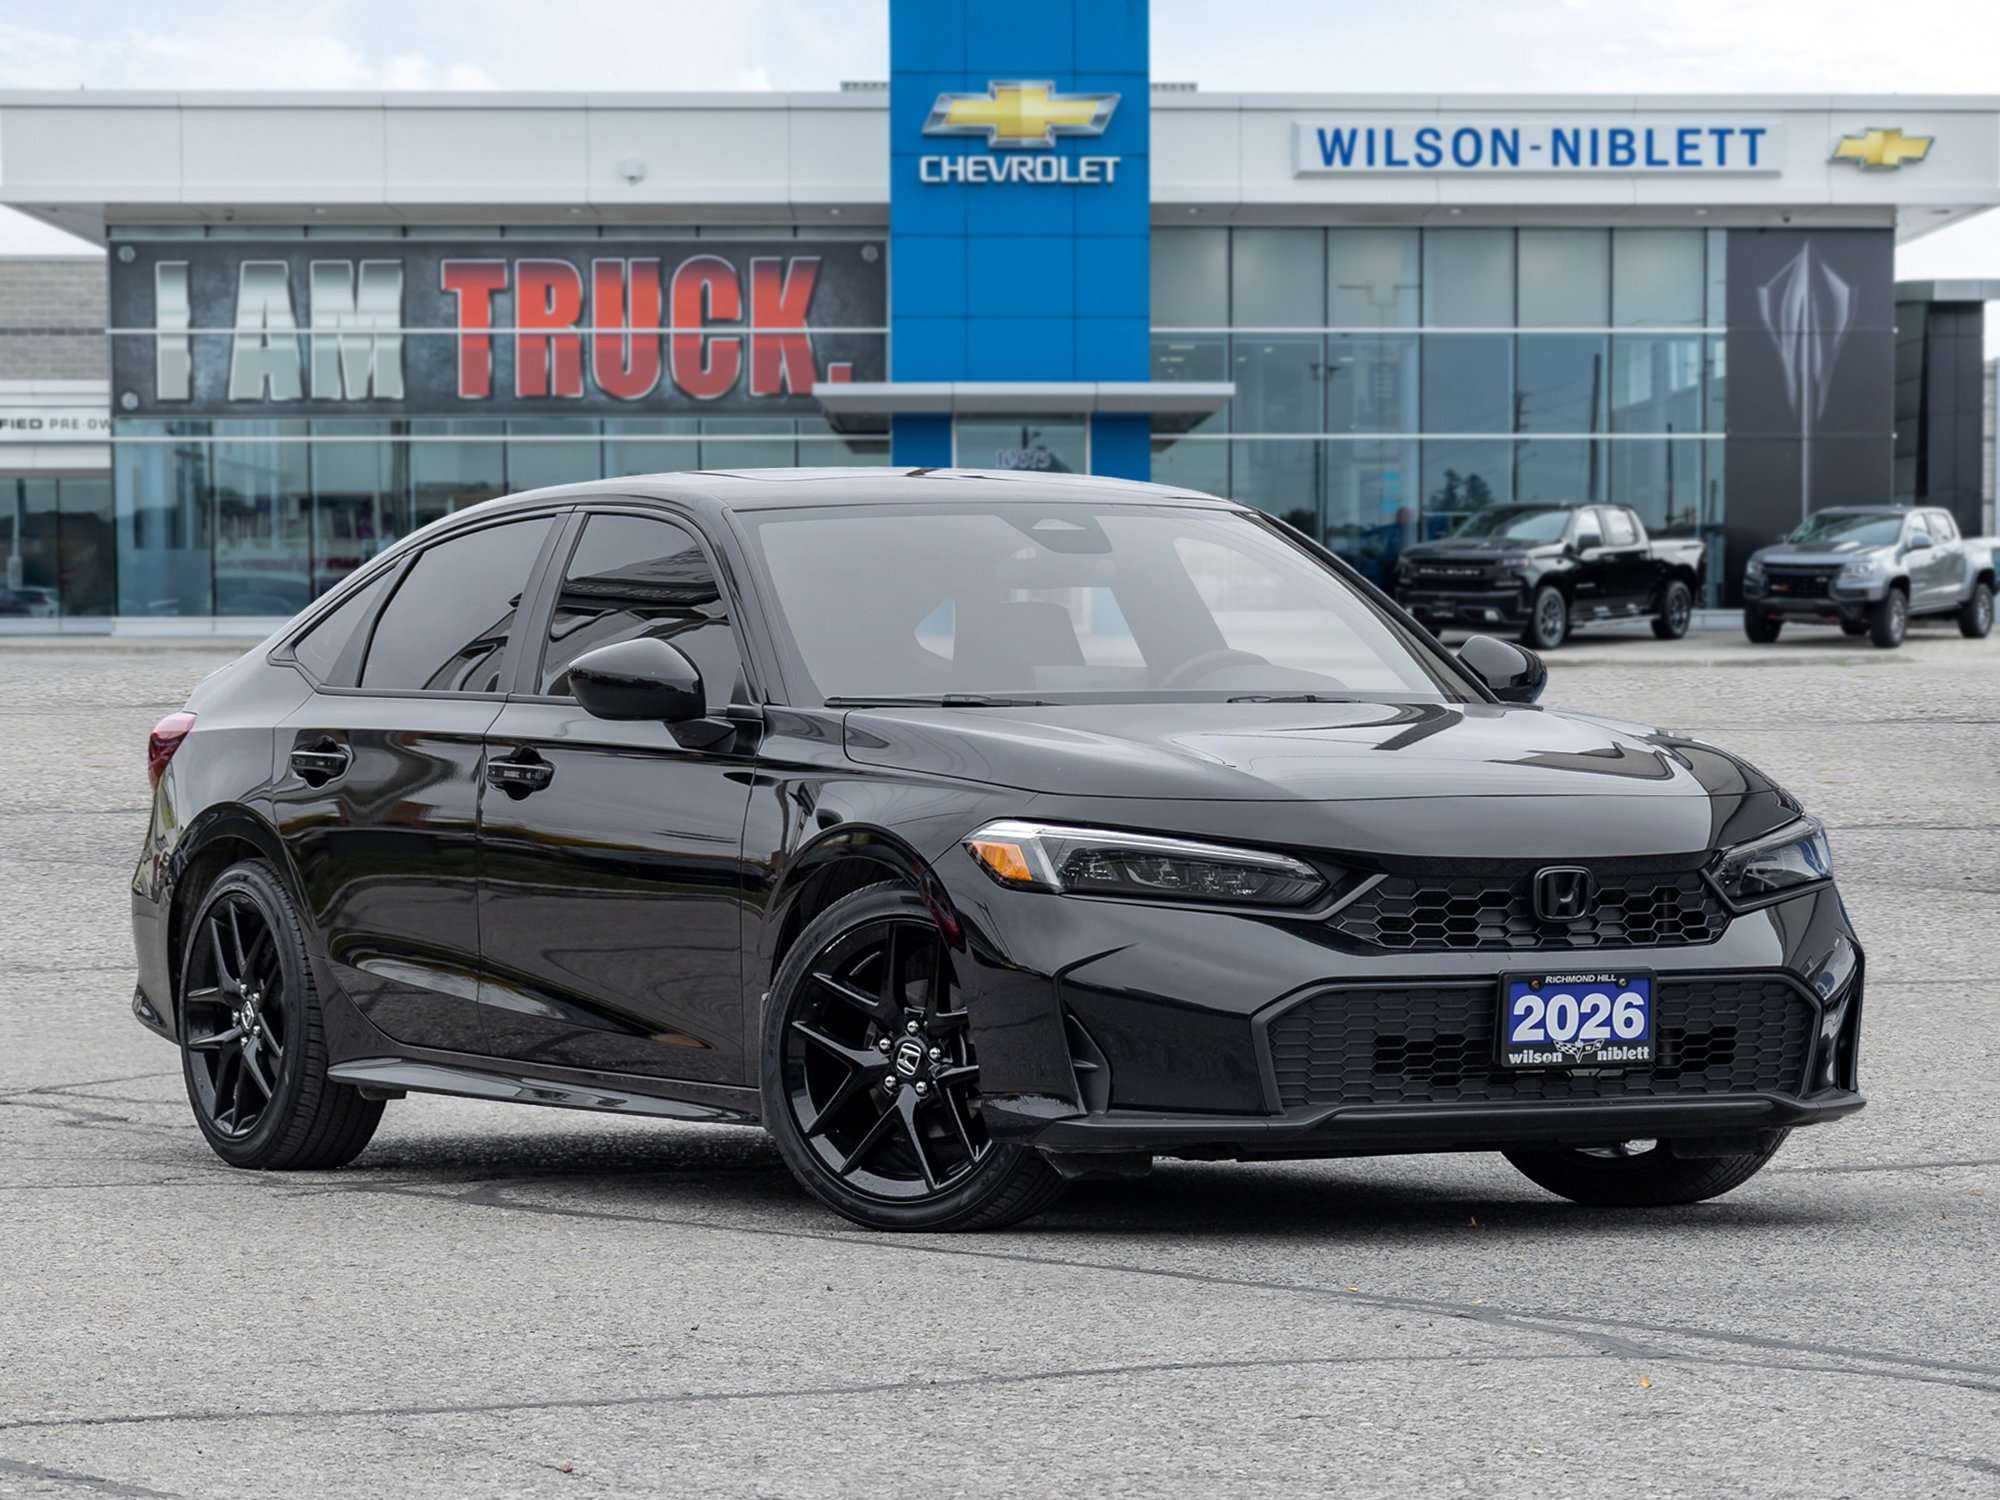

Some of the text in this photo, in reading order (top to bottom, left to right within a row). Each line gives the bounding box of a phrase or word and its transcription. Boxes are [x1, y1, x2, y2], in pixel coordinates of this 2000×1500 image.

[1316, 127, 1766, 168] WILSON-NIBLETT
[919, 155, 1120, 183] CHEVROLET
[155, 260, 192, 400] I
[228, 259, 404, 400] AM
[1545, 974, 1617, 984] RICHMOND HILL
[1512, 992, 1645, 1041] 2026
[1508, 1046, 1650, 1064] wilson niblett
